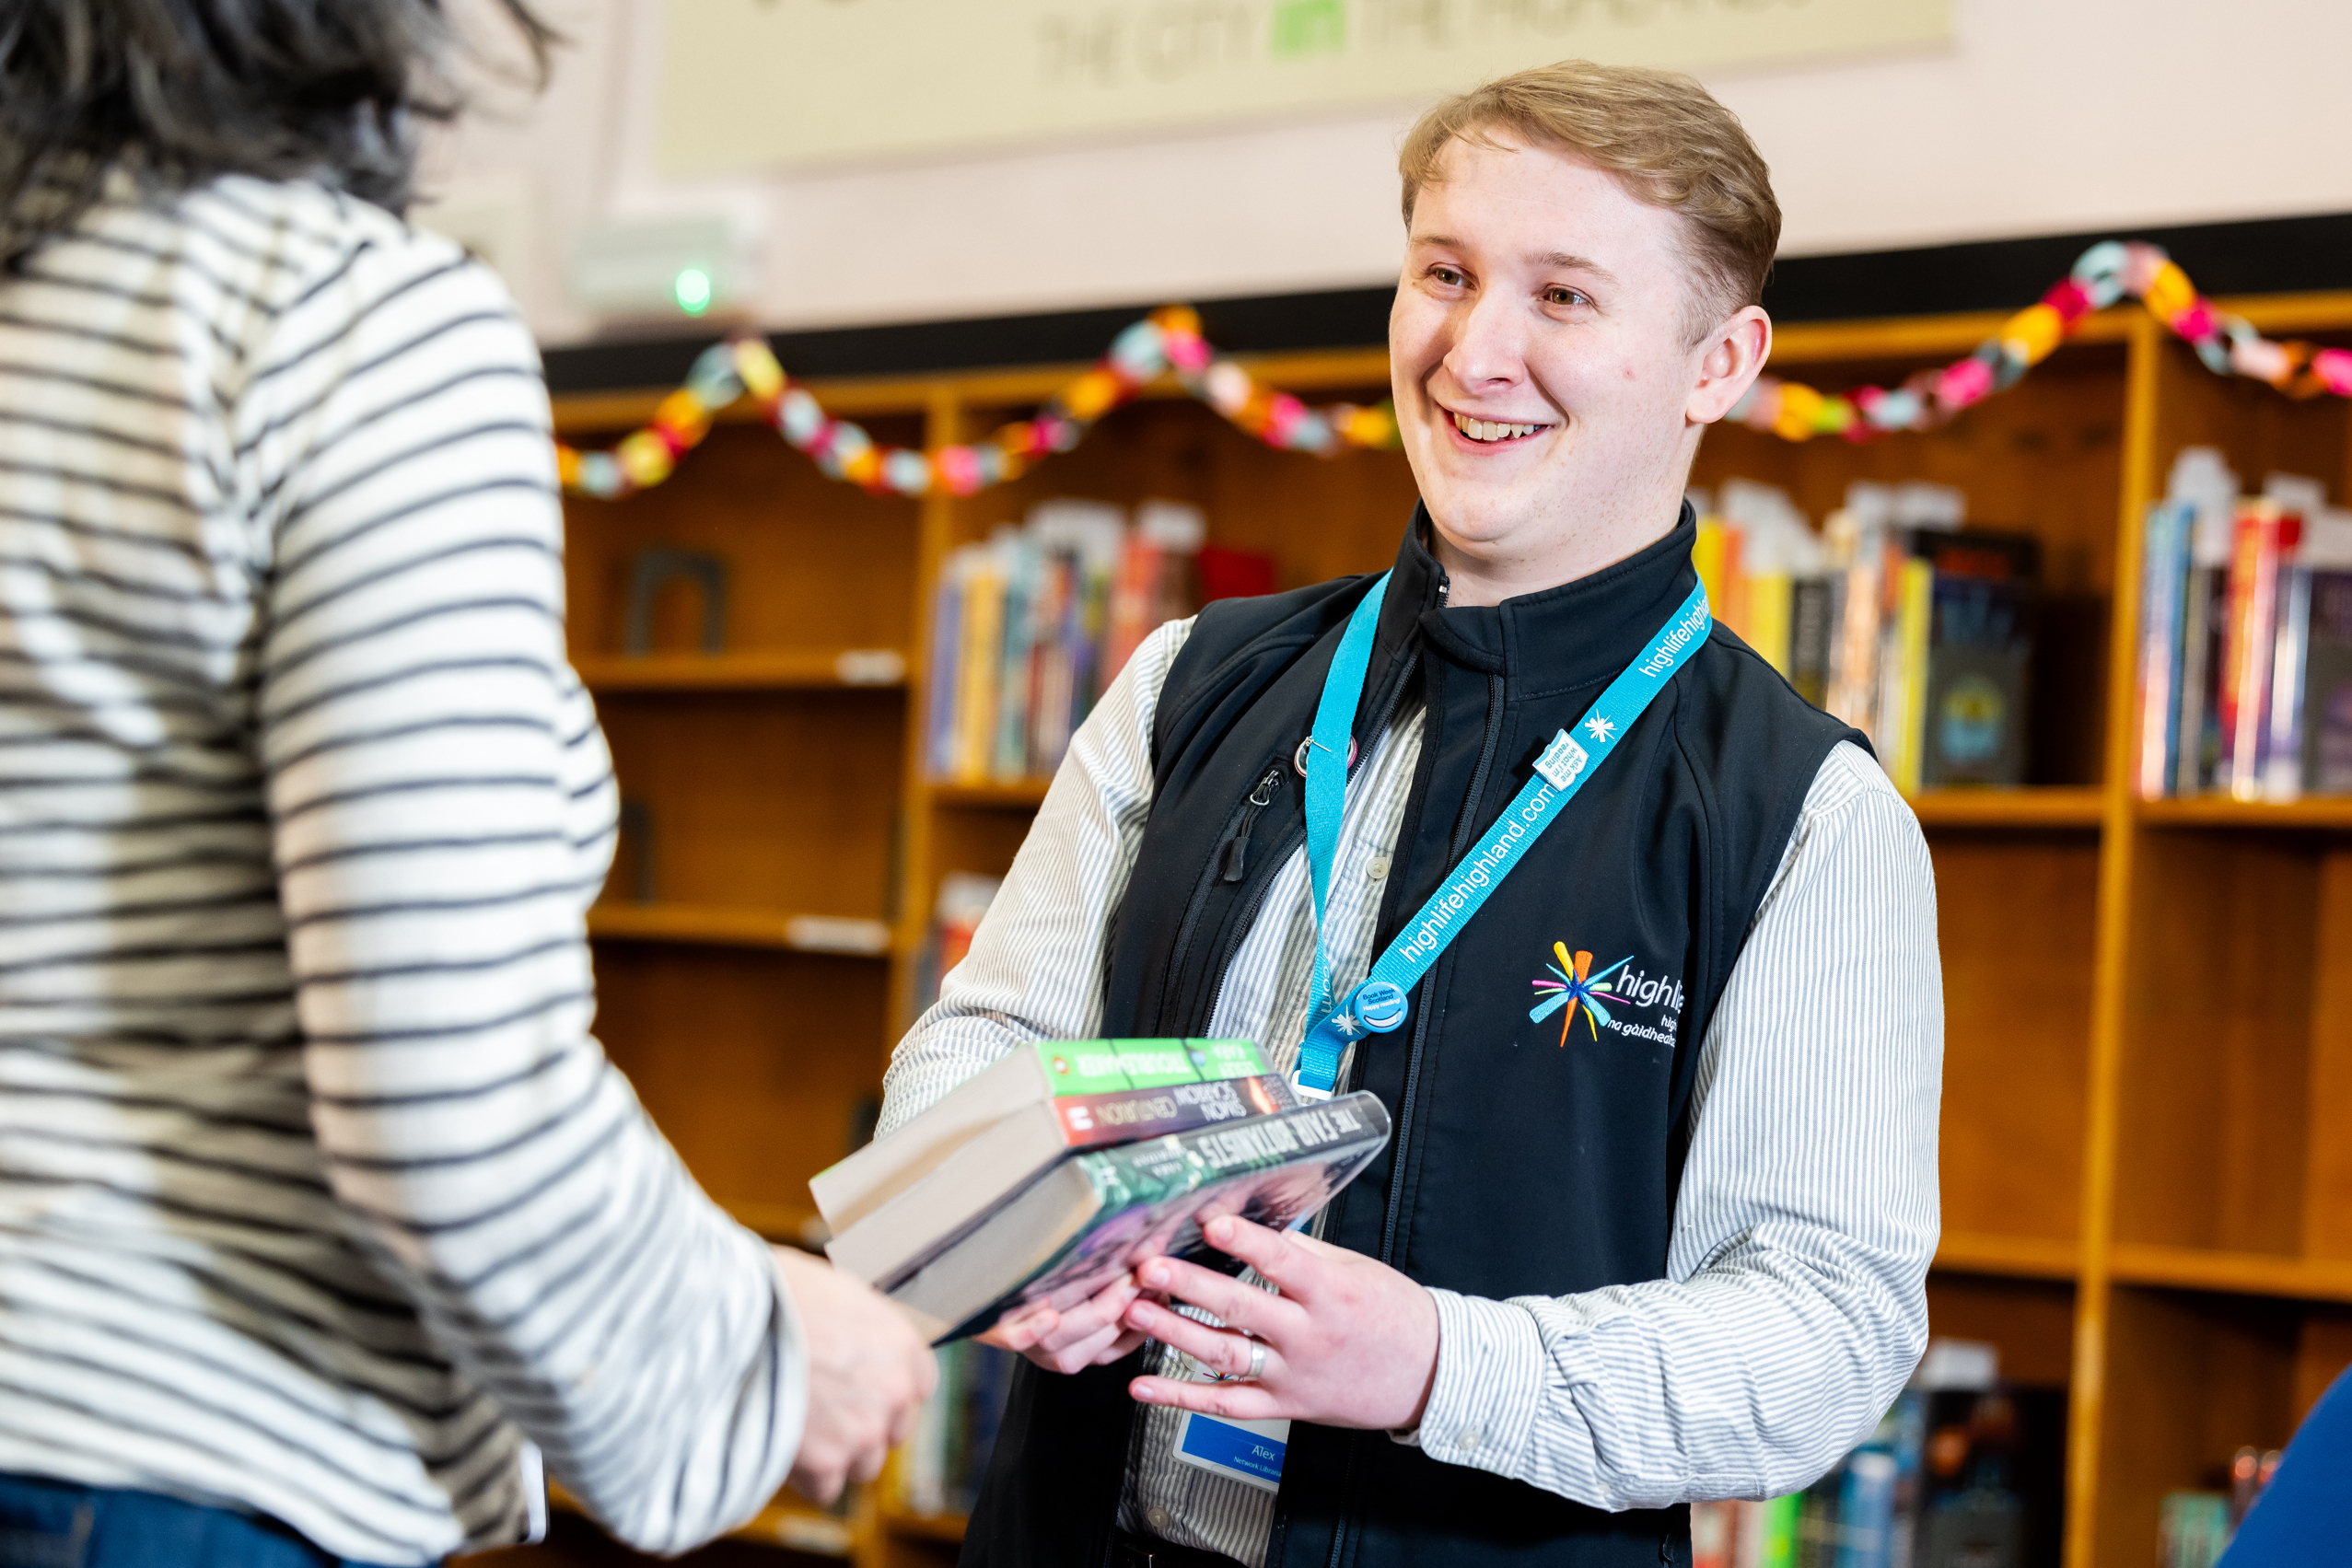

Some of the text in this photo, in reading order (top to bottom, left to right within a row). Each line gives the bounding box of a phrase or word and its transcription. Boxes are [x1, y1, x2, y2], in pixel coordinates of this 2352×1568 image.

[1562, 747, 1578, 766] what
[1560, 754, 1583, 783] Ask me
[1399, 783, 1555, 963] highlifehighland.com
[1363, 992, 1379, 1000] Book
[1368, 993, 1393, 1004] Scotland
[1380, 997, 1401, 1007] reading!
[1607, 1018, 1621, 1031] na
[1172, 1080, 1239, 1105] SCARROW
[1094, 1096, 1178, 1125] CENTURION
[1200, 1098, 1247, 1121] SIMON
[1197, 1109, 1362, 1169] THE FAIR BOTANISTS
[1234, 1456, 1258, 1469] Network
[1252, 1446, 1275, 1461] Alex
